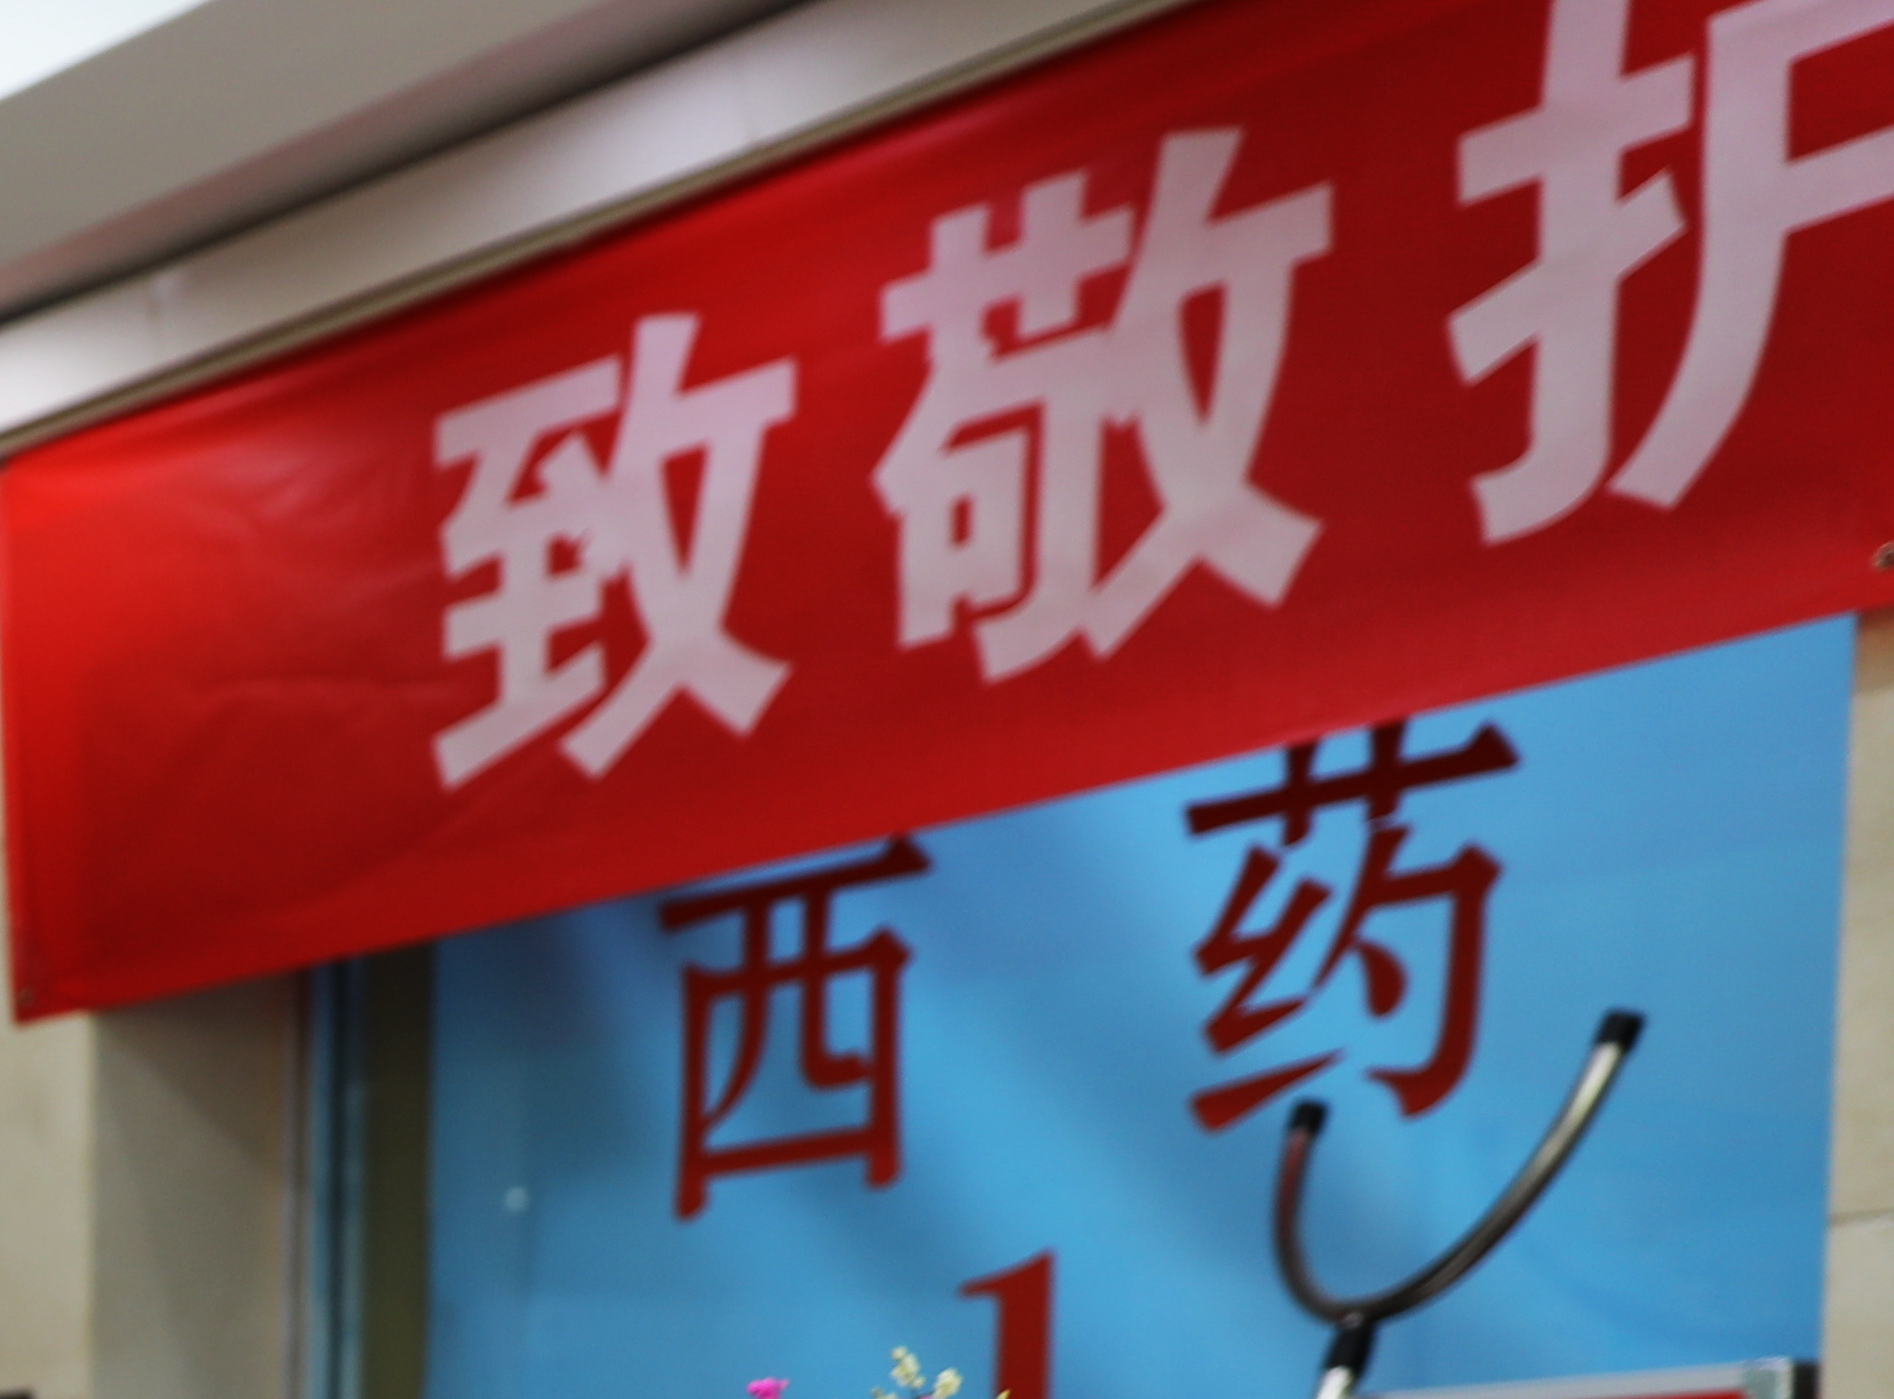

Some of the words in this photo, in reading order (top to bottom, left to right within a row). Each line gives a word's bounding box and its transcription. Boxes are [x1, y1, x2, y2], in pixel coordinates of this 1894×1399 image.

[430, 0, 1894, 790] 致敬护
[660, 719, 1520, 1220] 西药
